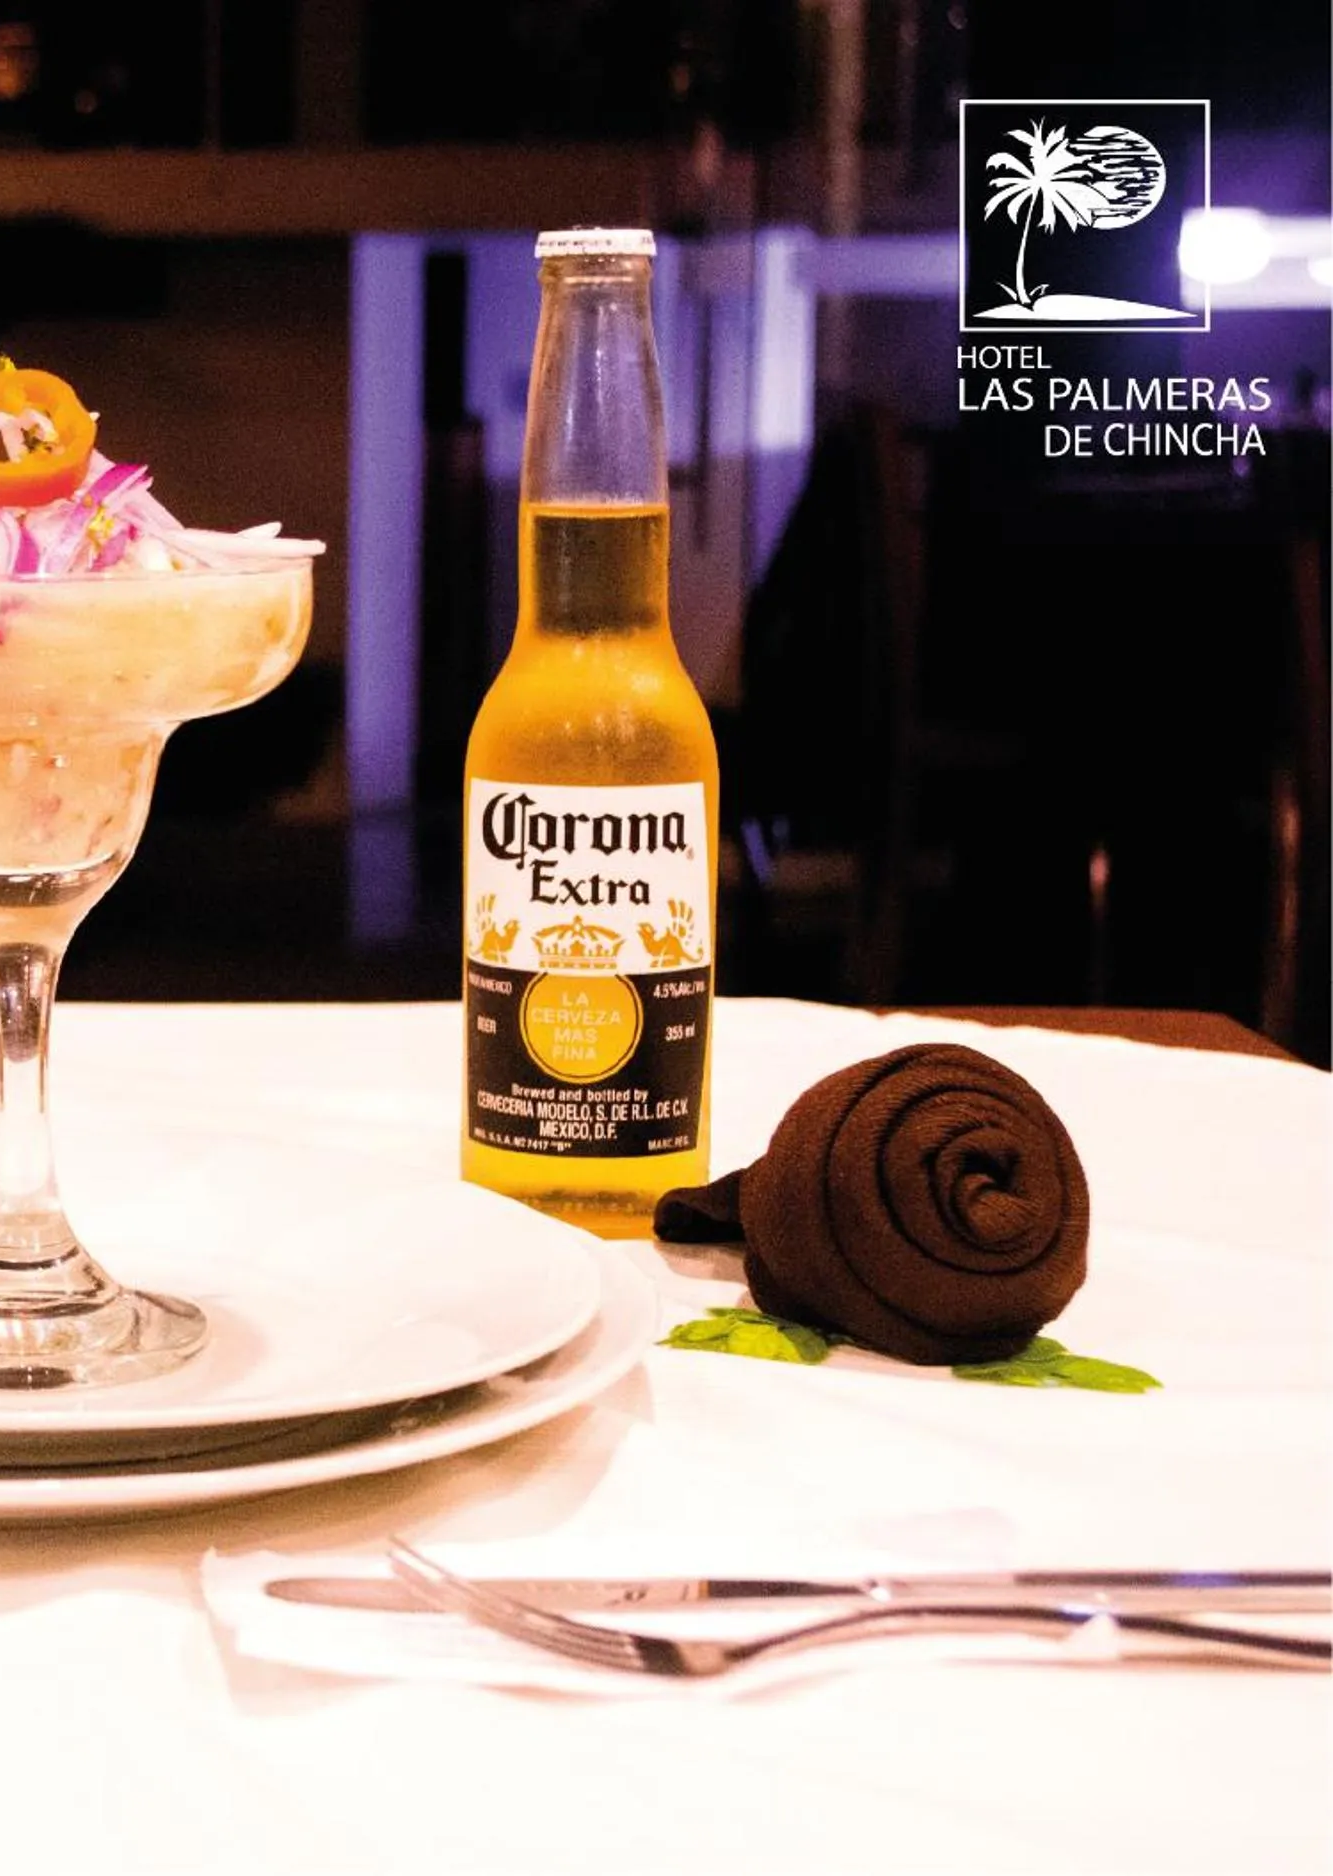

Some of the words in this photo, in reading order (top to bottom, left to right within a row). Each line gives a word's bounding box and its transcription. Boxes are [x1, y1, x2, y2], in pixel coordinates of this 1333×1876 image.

[482, 792, 687, 870] Corona
[529, 859, 651, 906] Extra
[562, 992, 590, 1007] LA
[531, 1007, 622, 1025] CERVEZA
[554, 1028, 598, 1043] MAS
[666, 1024, 684, 1041] 355
[552, 1048, 597, 1061] FINA
[511, 1082, 555, 1100] Brewed
[559, 1088, 582, 1101] and
[587, 1088, 631, 1102] bottled
[634, 1087, 649, 1103] by
[477, 1089, 534, 1118] CERVECERIA
[537, 1101, 593, 1123] MODELO,
[596, 1103, 609, 1121] S.
[611, 1103, 628, 1121] DE
[632, 1103, 654, 1121] R.L.
[656, 1100, 670, 1119] DE
[539, 1120, 593, 1142] MEXICO,
[595, 1121, 618, 1139] D.F.
